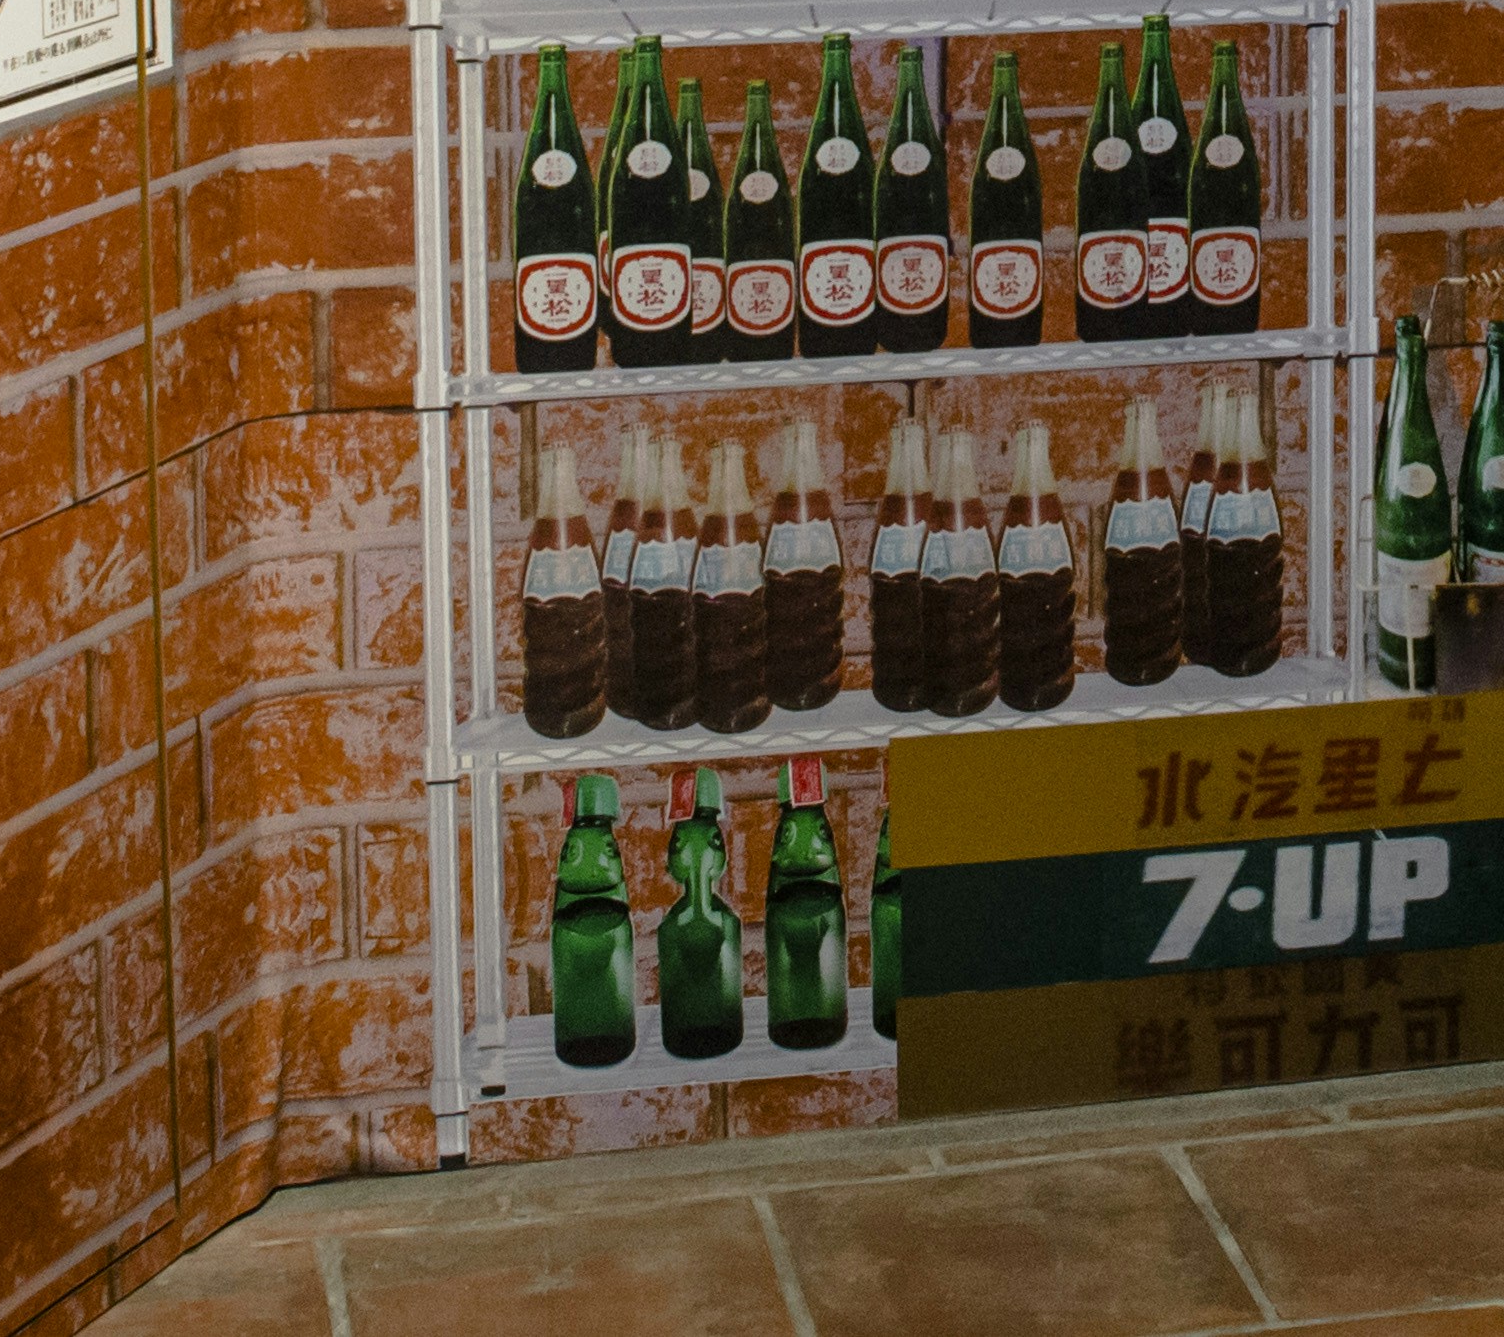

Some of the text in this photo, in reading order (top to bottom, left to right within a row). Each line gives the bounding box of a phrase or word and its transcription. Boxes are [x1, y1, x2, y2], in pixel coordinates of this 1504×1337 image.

[826, 261, 854, 301] 黑松
[899, 256, 925, 293] 黑松
[993, 261, 1022, 298] 黑松
[1099, 251, 1128, 288] 黑松
[1210, 248, 1239, 284] 黑松
[541, 277, 574, 317] 黑松
[636, 268, 667, 308] 黑松
[747, 281, 775, 314] 黑松
[1136, 733, 1465, 830] 七星汽水
